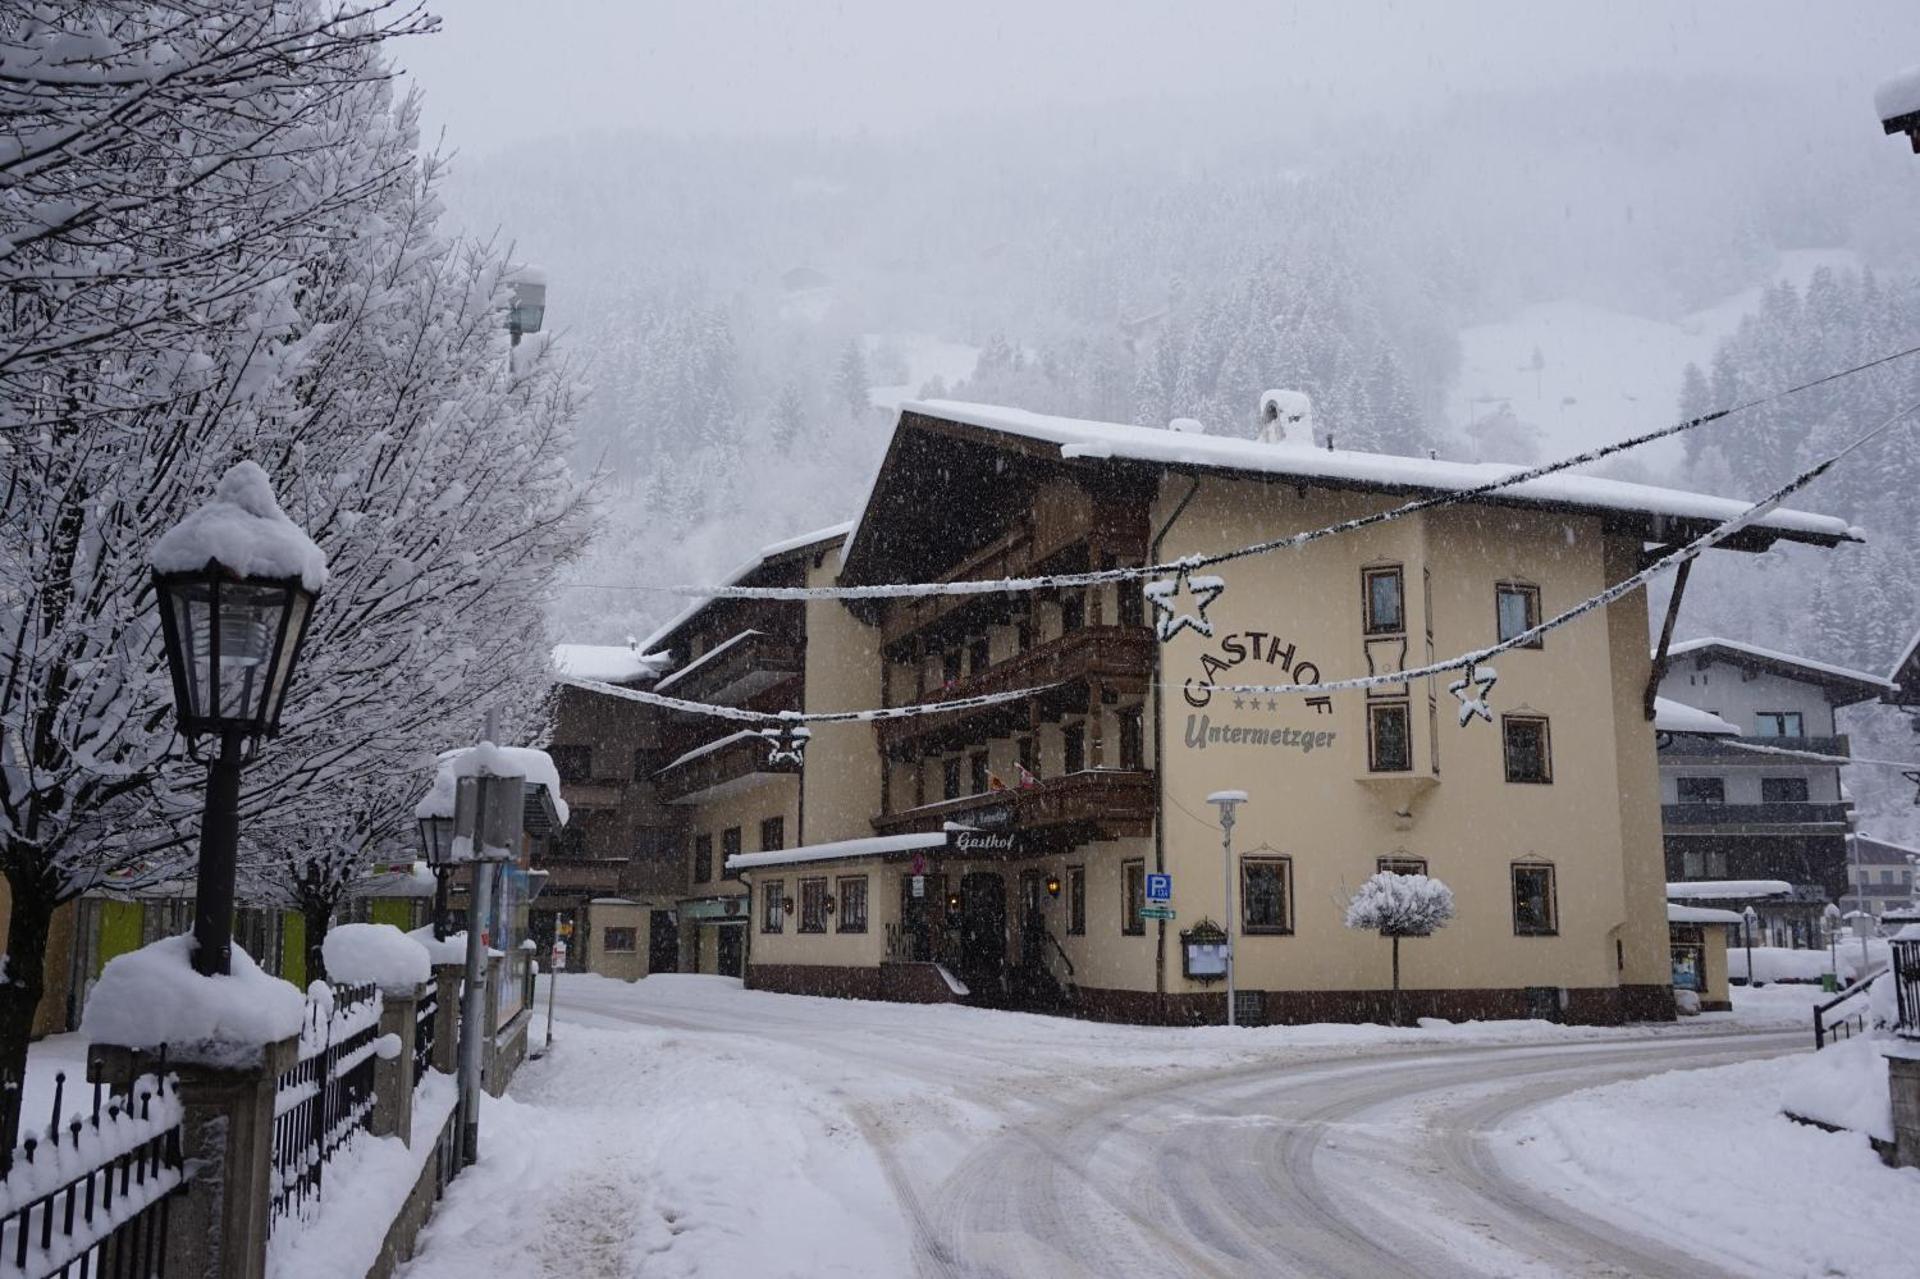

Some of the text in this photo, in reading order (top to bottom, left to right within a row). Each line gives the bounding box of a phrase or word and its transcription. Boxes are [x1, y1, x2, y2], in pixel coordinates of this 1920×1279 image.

[1184, 631, 1333, 714] GASTHOF
[1185, 714, 1336, 753] Untermetzger
[957, 832, 1015, 850] Gasthof
[1152, 877, 1167, 896] P
